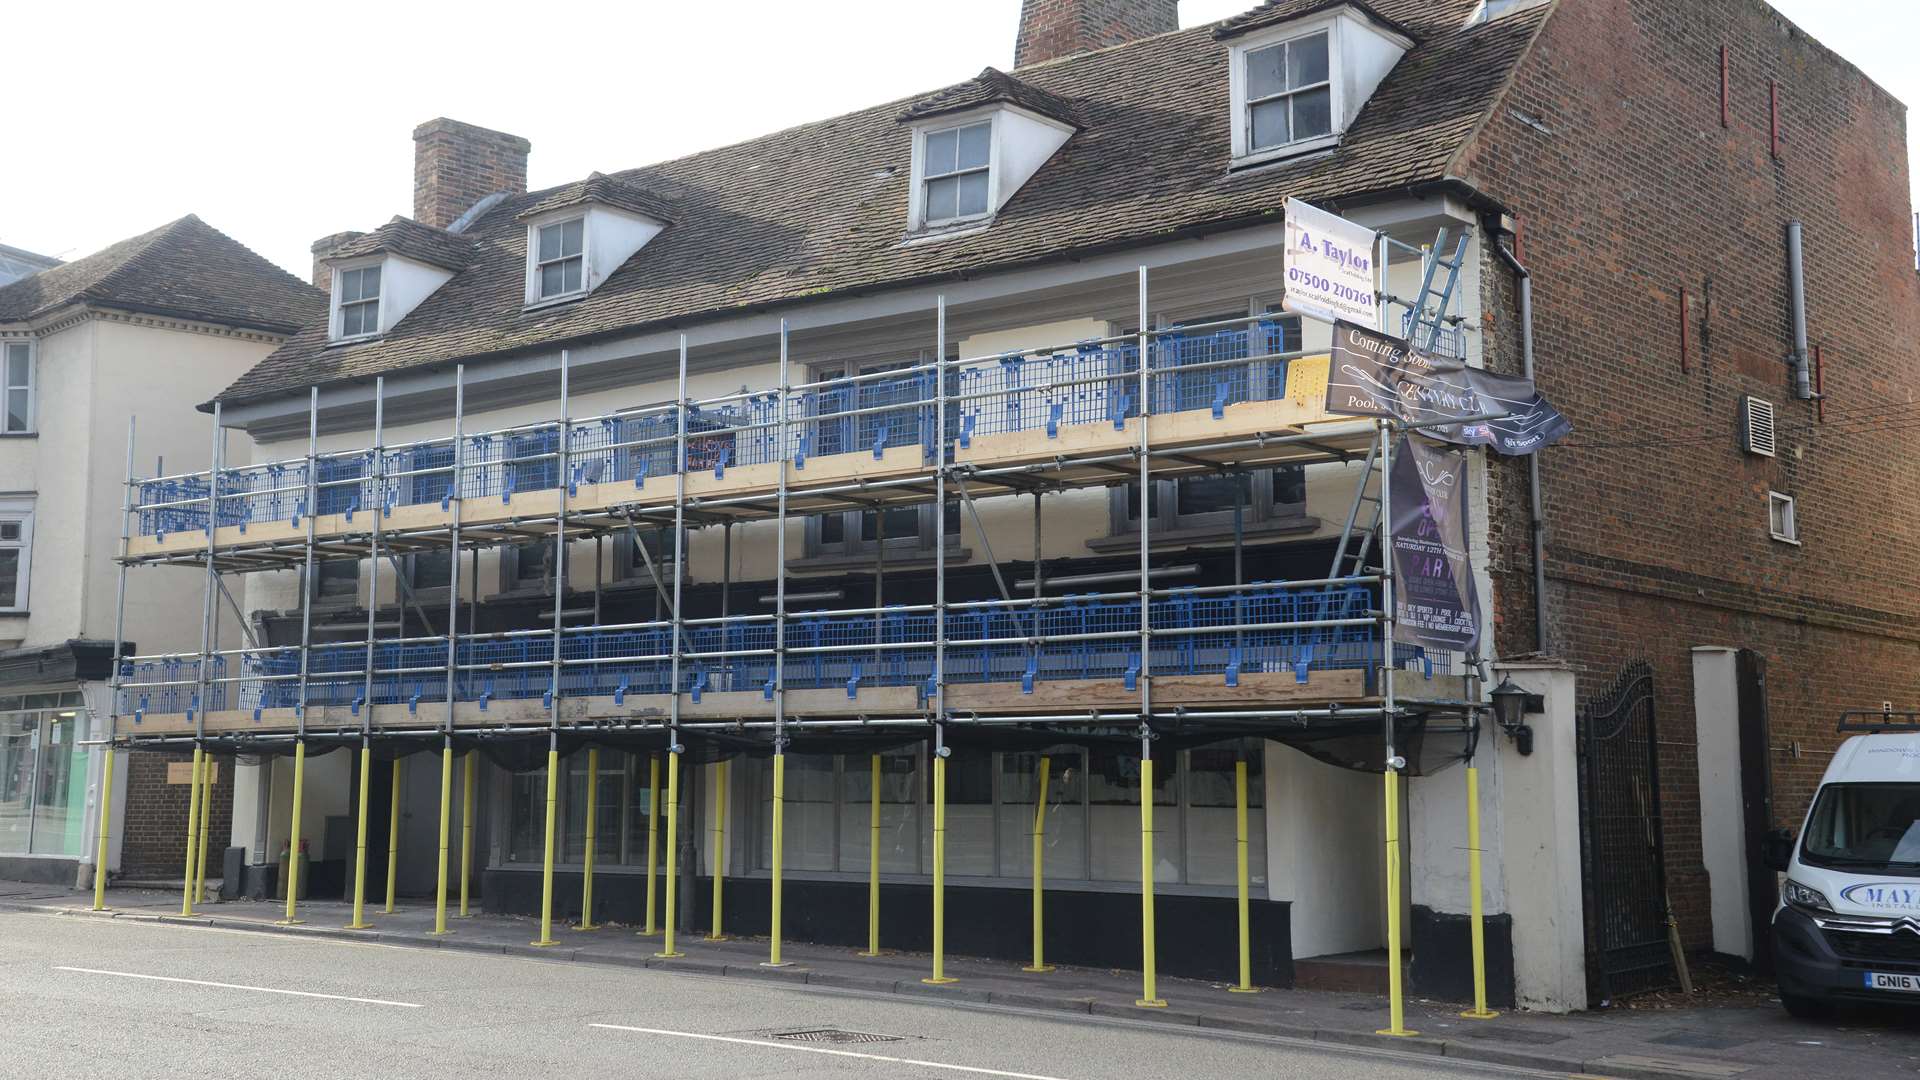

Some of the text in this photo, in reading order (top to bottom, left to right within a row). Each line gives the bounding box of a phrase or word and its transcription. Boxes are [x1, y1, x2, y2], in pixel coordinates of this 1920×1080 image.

[1301, 232, 1369, 271] A. Taylor
[1289, 267, 1372, 307] 07500 270761
[1350, 329, 1402, 363] Coming
[1348, 395, 1378, 409] Pool,
[1397, 381, 1457, 409] CENTURY
[1516, 434, 1541, 447] Sport
[1395, 541, 1425, 552] SATURDAY
[1426, 546, 1442, 554] 12TH
[1417, 605, 1433, 614] SPORTS
[1866, 888, 1920, 904] MAY
[1877, 975, 1911, 988] GN16
